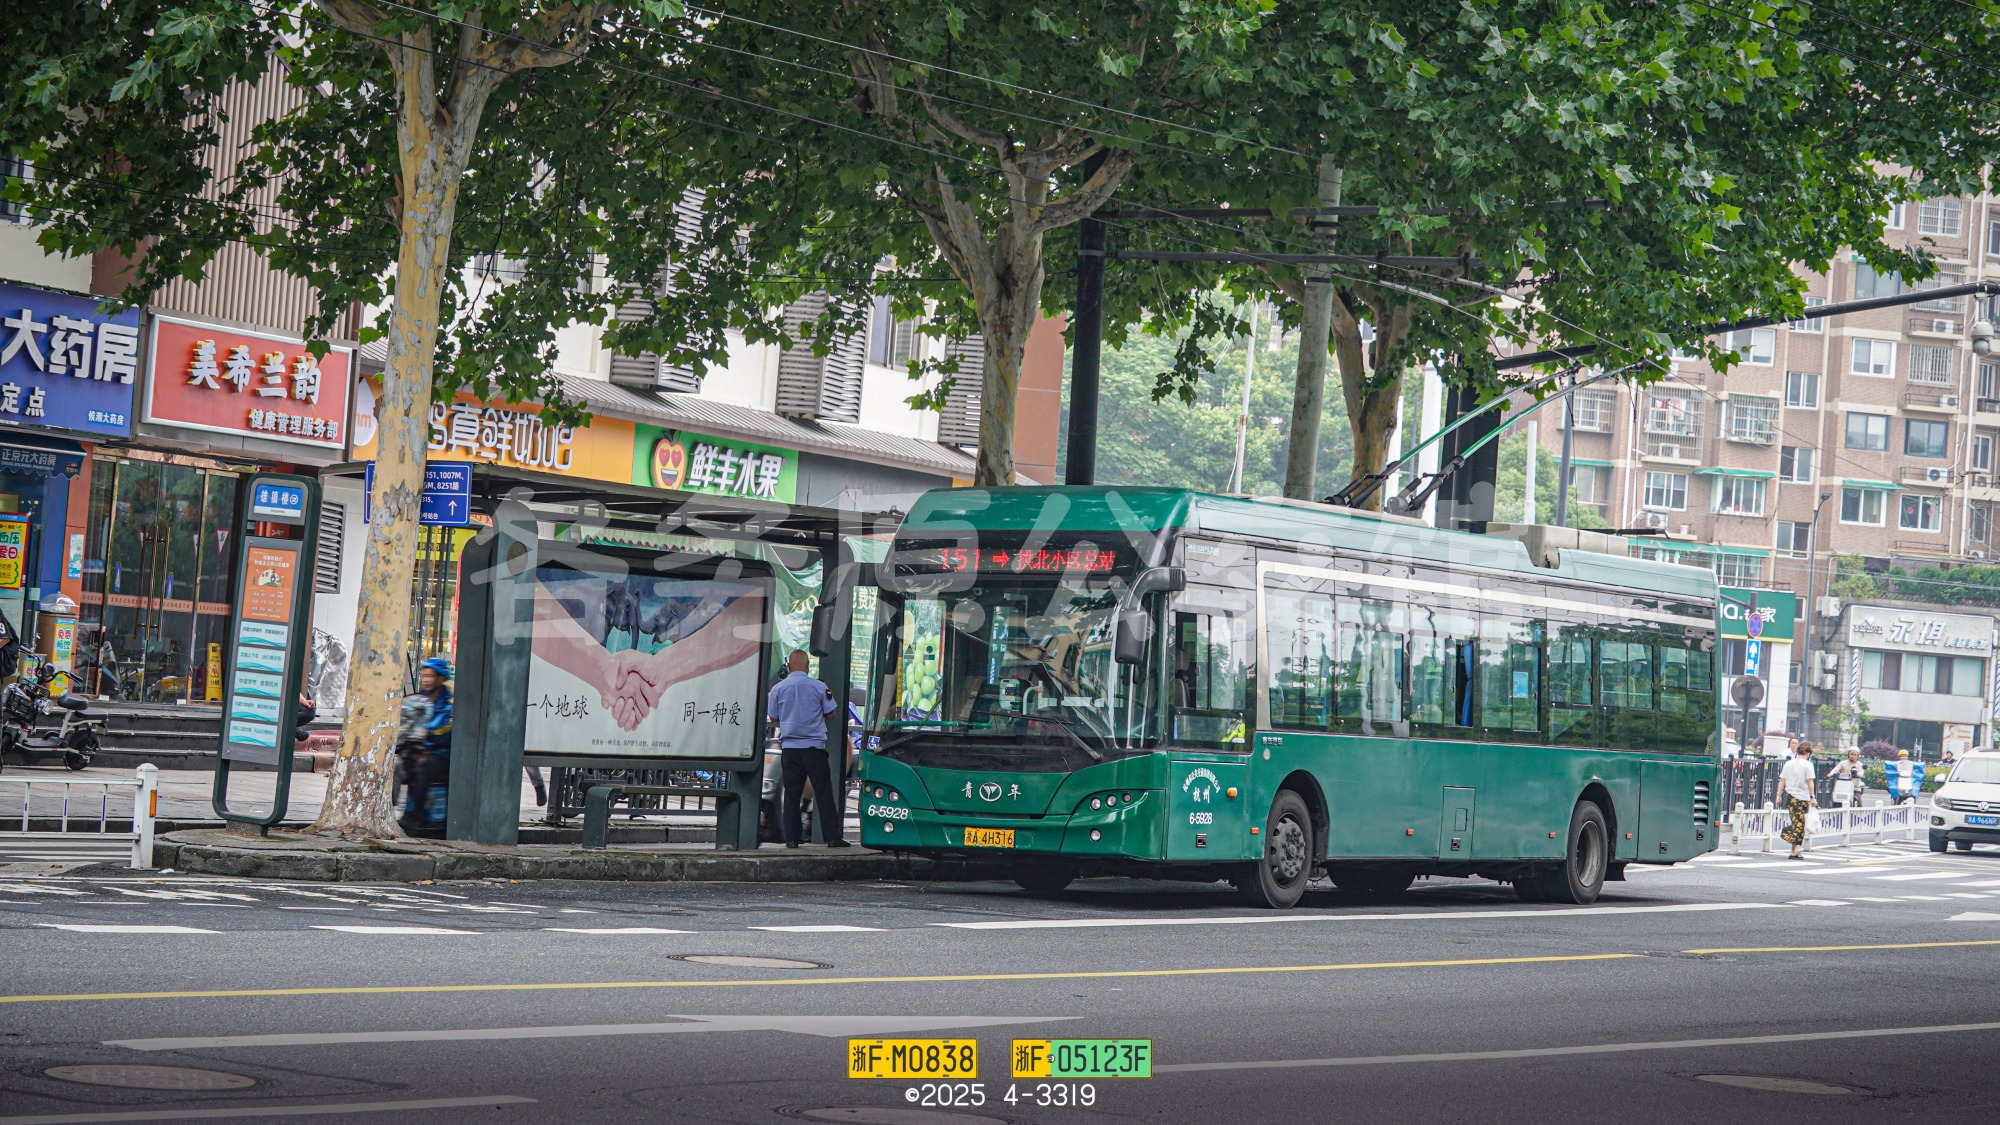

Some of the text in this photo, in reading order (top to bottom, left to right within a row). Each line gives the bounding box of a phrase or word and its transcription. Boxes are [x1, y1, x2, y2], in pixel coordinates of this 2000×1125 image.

[1, 309, 139, 384] 大药房
[187, 340, 322, 404] 美希兰韵
[0, 382, 46, 417] 定点
[248, 409, 339, 439] 健康管理服务部
[688, 443, 782, 498] 鲜丰水果
[938, 549, 1116, 571] 151 拱北小区总站
[1886, 617, 1947, 645] 永琪
[526, 694, 590, 719] 一个地球
[683, 701, 742, 726] 同一种爱
[961, 781, 1022, 801] 青 年
[1193, 785, 1211, 804] 杭州
[867, 804, 909, 820] 6-5928
[1189, 812, 1213, 825] 6-5928
